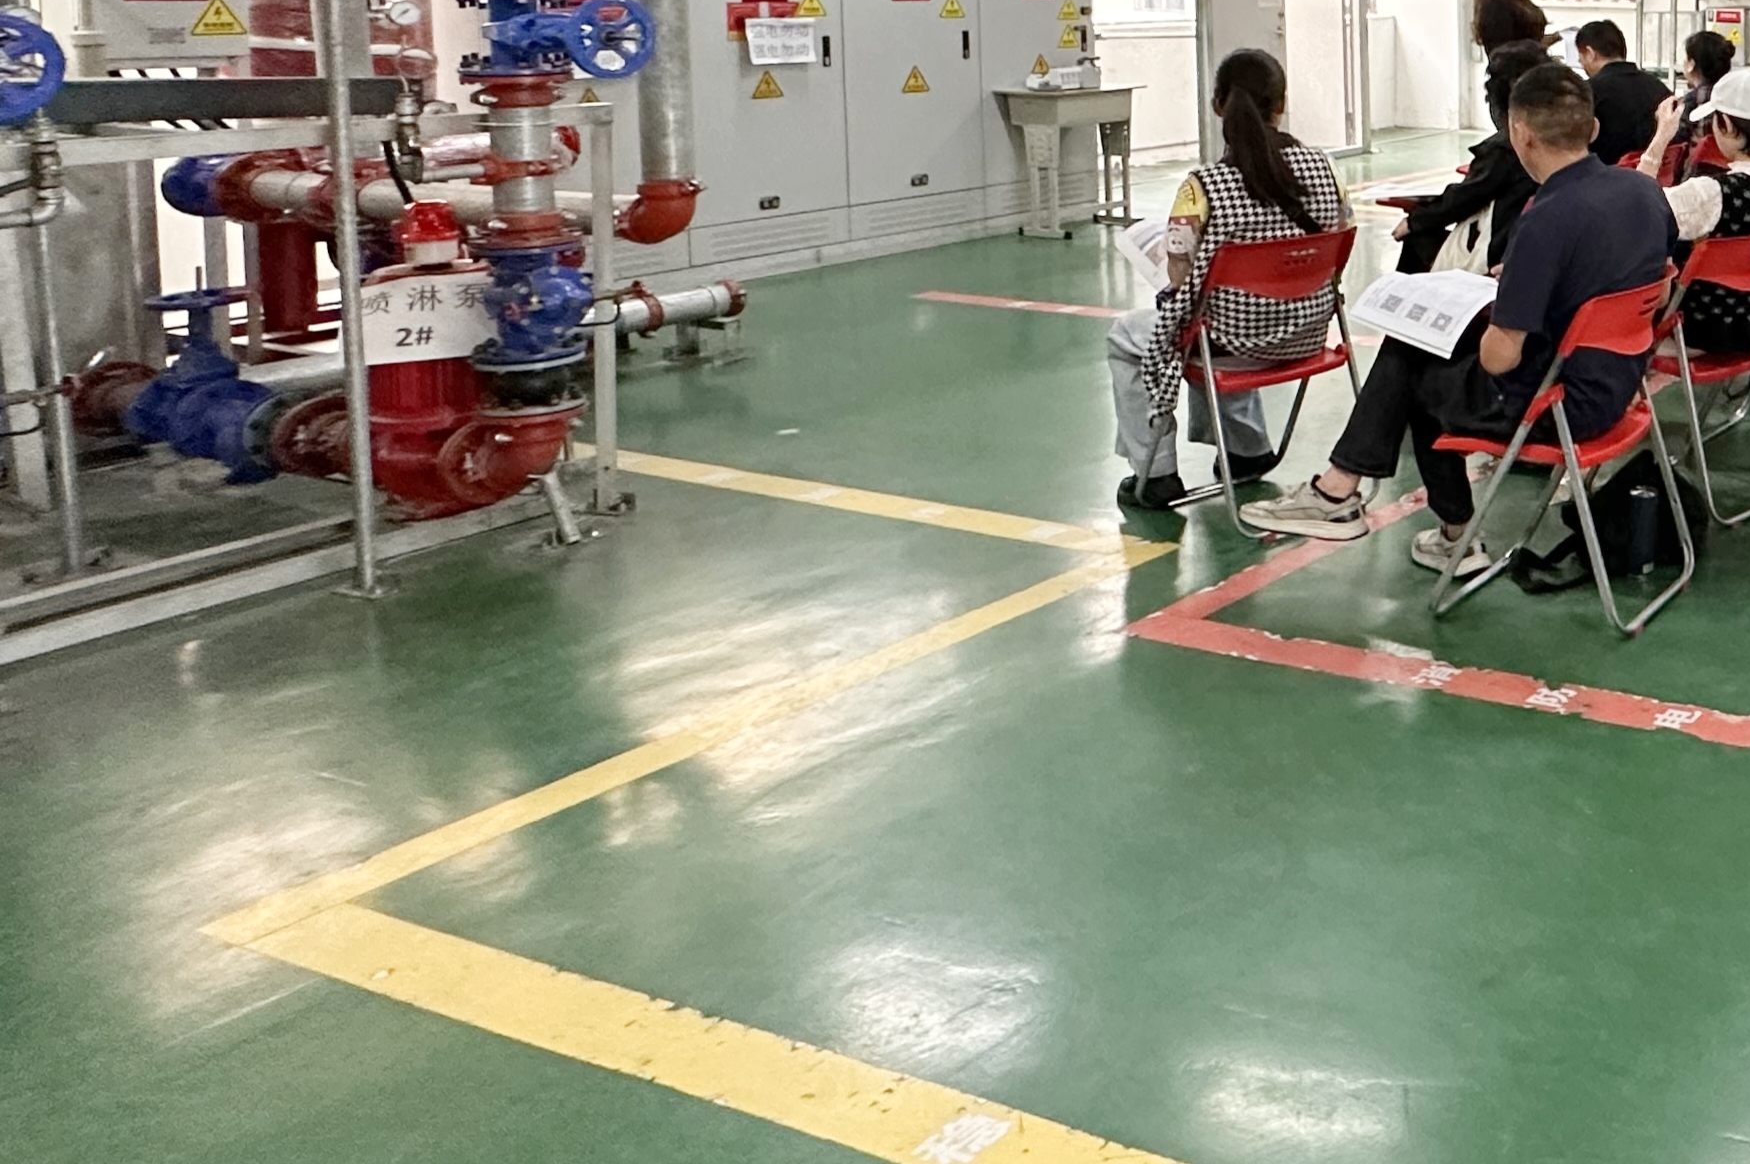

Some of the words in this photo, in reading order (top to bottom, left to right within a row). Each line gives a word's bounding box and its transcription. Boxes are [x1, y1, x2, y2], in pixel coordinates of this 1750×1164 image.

[361, 282, 489, 316] 喷淋泵
[396, 326, 434, 347] 2#
